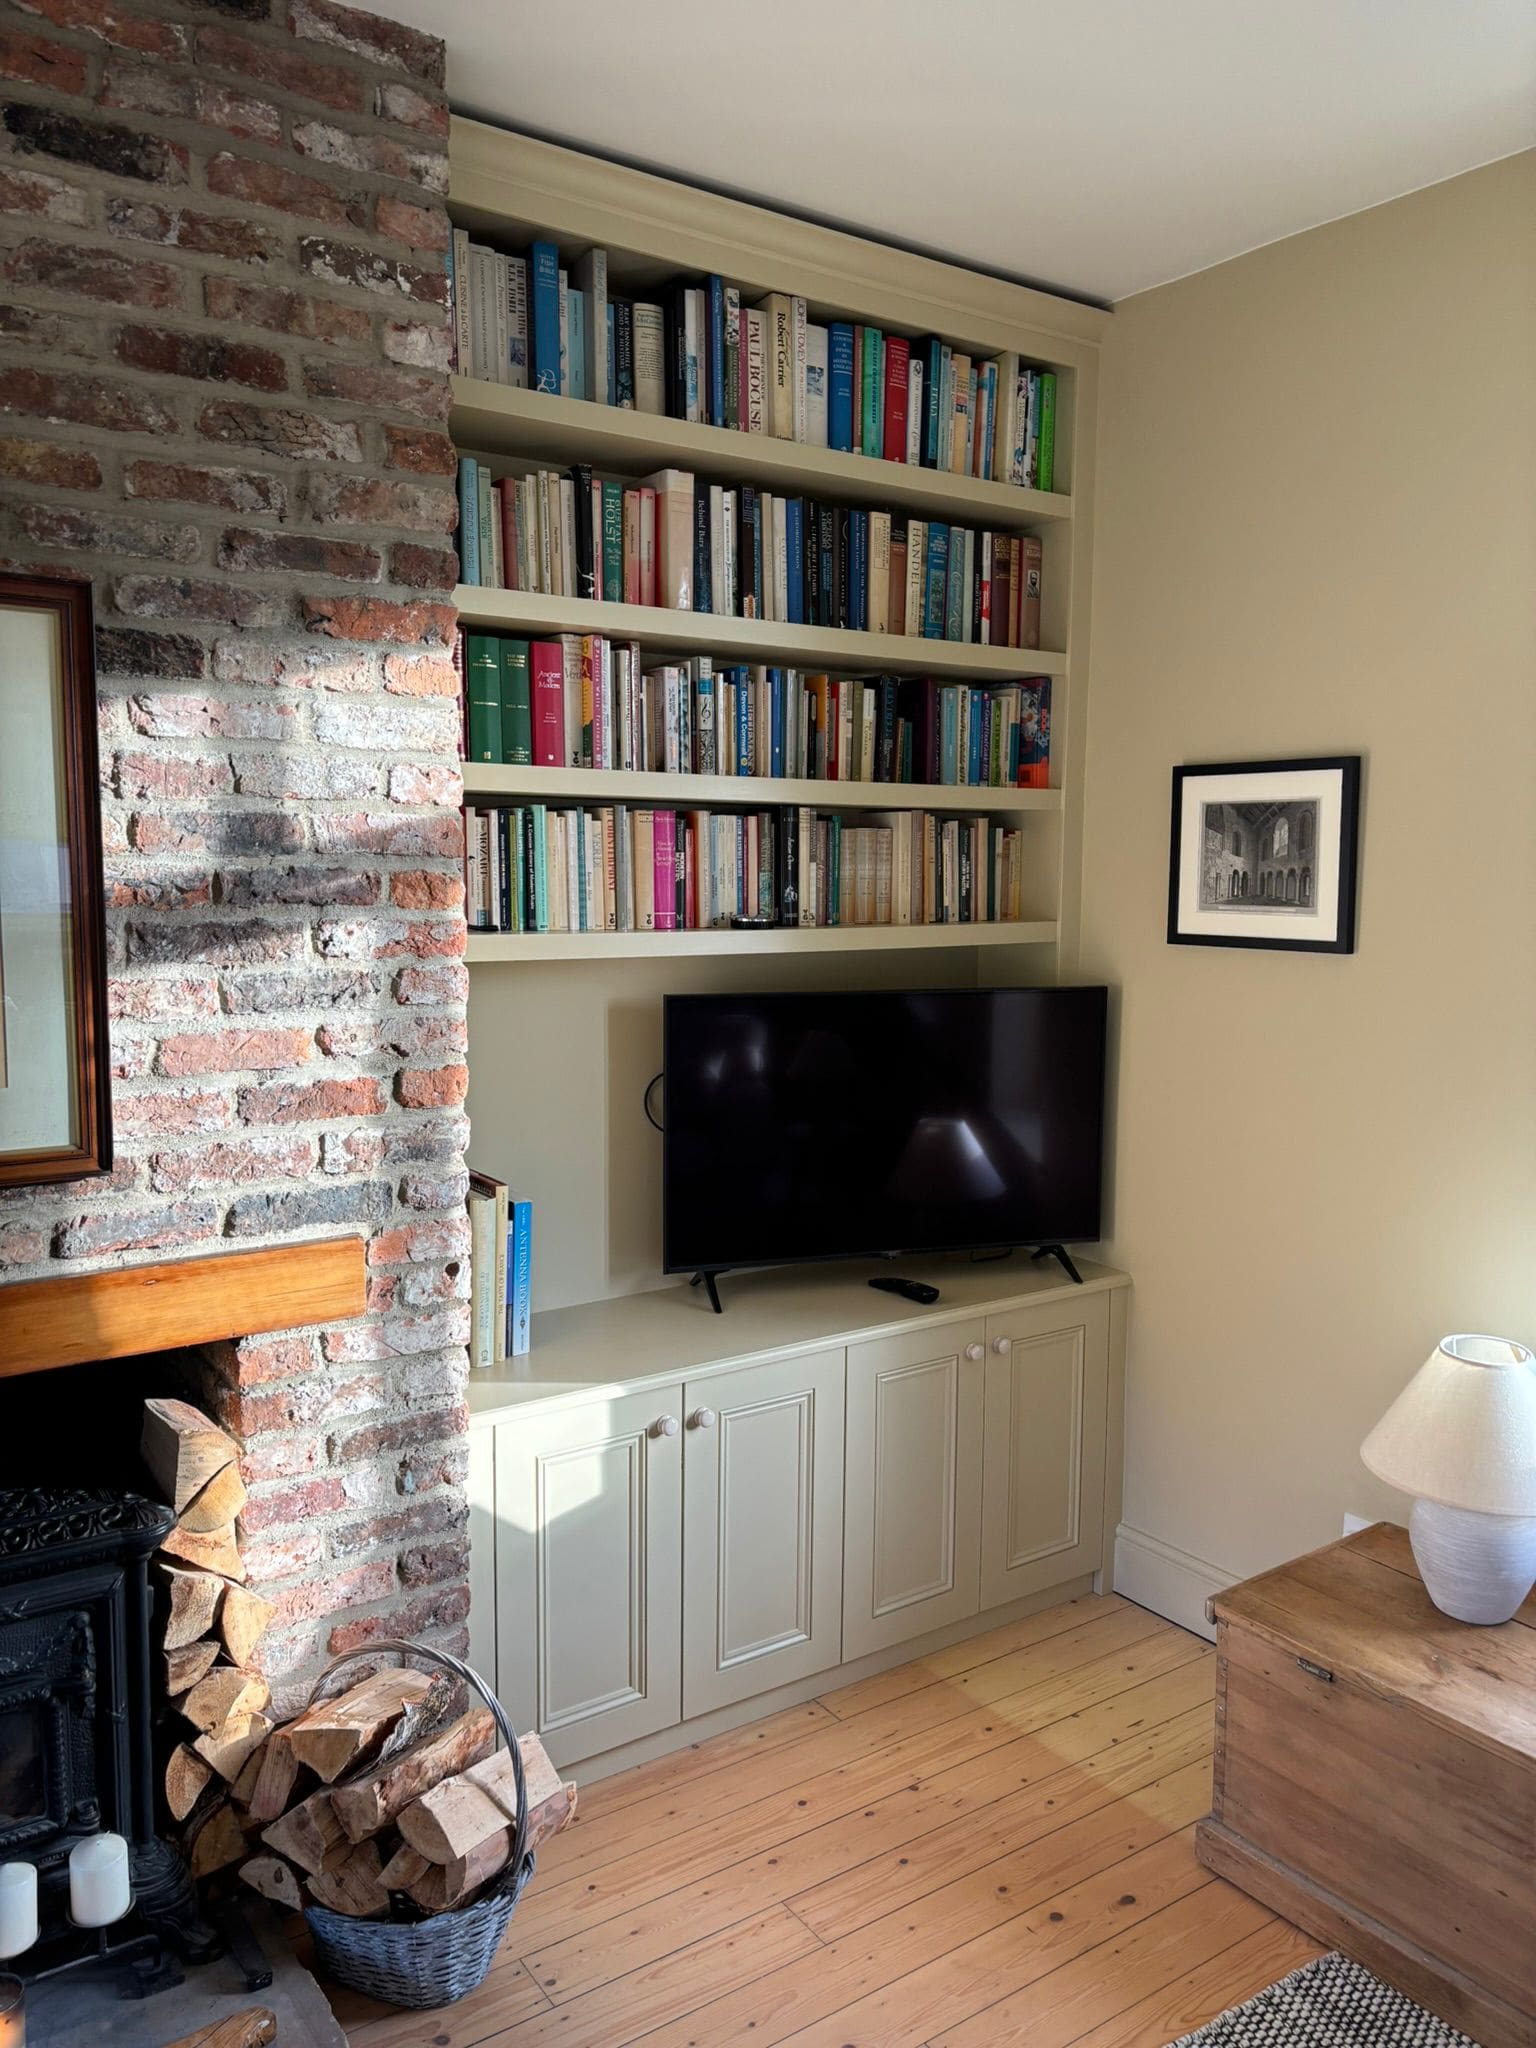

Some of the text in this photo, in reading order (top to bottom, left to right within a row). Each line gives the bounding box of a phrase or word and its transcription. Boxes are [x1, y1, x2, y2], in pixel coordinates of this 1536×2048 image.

[617, 304, 626, 326] FOOD
[797, 300, 806, 331] JOHN
[618, 337, 627, 370] HISTORY
[624, 327, 632, 368] TANNAHILL
[777, 312, 788, 388] Robert Carrier
[797, 332, 806, 366] TOVEY
[749, 320, 762, 432] PAUL BOCUSE
[605, 498, 617, 544] HOLST
[698, 500, 708, 529] Behind
[825, 512, 833, 550] OPERA
[698, 531, 707, 548] Bars
[820, 519, 828, 549] HISTORY
[911, 527, 922, 588] HANDEL
[740, 690, 748, 716] Devon
[740, 724, 748, 756] Cornwall
[479, 832, 489, 876] MOZART
[592, 833, 602, 868] VERDI
[607, 819, 616, 892] COUNTERPOINT
[519, 1228, 529, 1284] ANTENNA
[518, 1285, 529, 1317] BOOK
